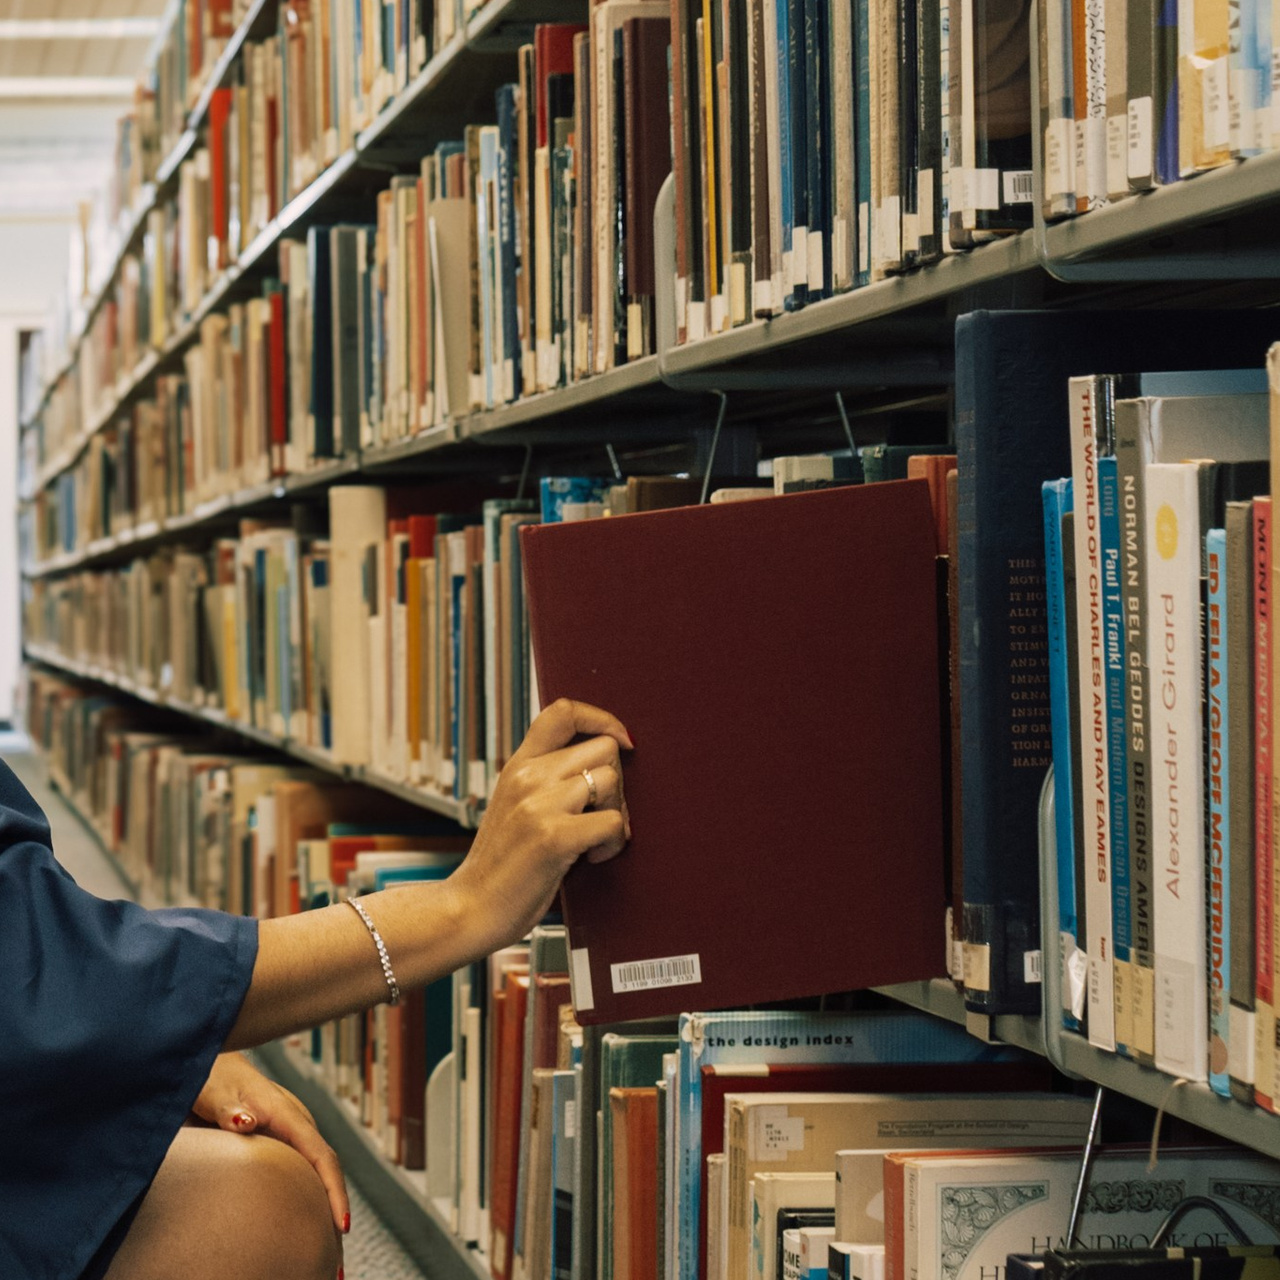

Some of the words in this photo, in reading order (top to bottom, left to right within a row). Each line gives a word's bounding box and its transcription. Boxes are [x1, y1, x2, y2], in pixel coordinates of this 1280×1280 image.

[1081, 389, 1094, 438] THE
[1084, 443, 1097, 531] WORLD
[1087, 534, 1098, 569] OF
[1124, 475, 1139, 587] NORMAN
[1105, 548, 1120, 588] Paul
[1209, 553, 1221, 595] ED
[1010, 609, 1037, 618] ALLY
[1106, 593, 1120, 608] T.
[1127, 597, 1140, 643] BEL
[1010, 625, 1026, 634] TO
[1089, 574, 1102, 688] CHARLES
[1107, 613, 1122, 670] Frankl
[1160, 594, 1177, 710] Girard
[1011, 658, 1036, 668] AND
[1092, 693, 1104, 743] AND
[1129, 650, 1145, 752] GEDDES
[1012, 724, 1027, 733] OF
[1012, 741, 1040, 750] TION
[1094, 749, 1105, 793] RAY
[1133, 760, 1148, 872] DESIGNS
[1163, 722, 1180, 900] Alexander
[1095, 799, 1107, 884] EAMES
[1135, 879, 1150, 967] AMERI
[708, 1036, 735, 1047] the
[743, 1035, 799, 1049] design
[806, 1034, 854, 1045] index
[1032, 1234, 1188, 1254] HANDBOK
[1194, 1232, 1229, 1248] OF
